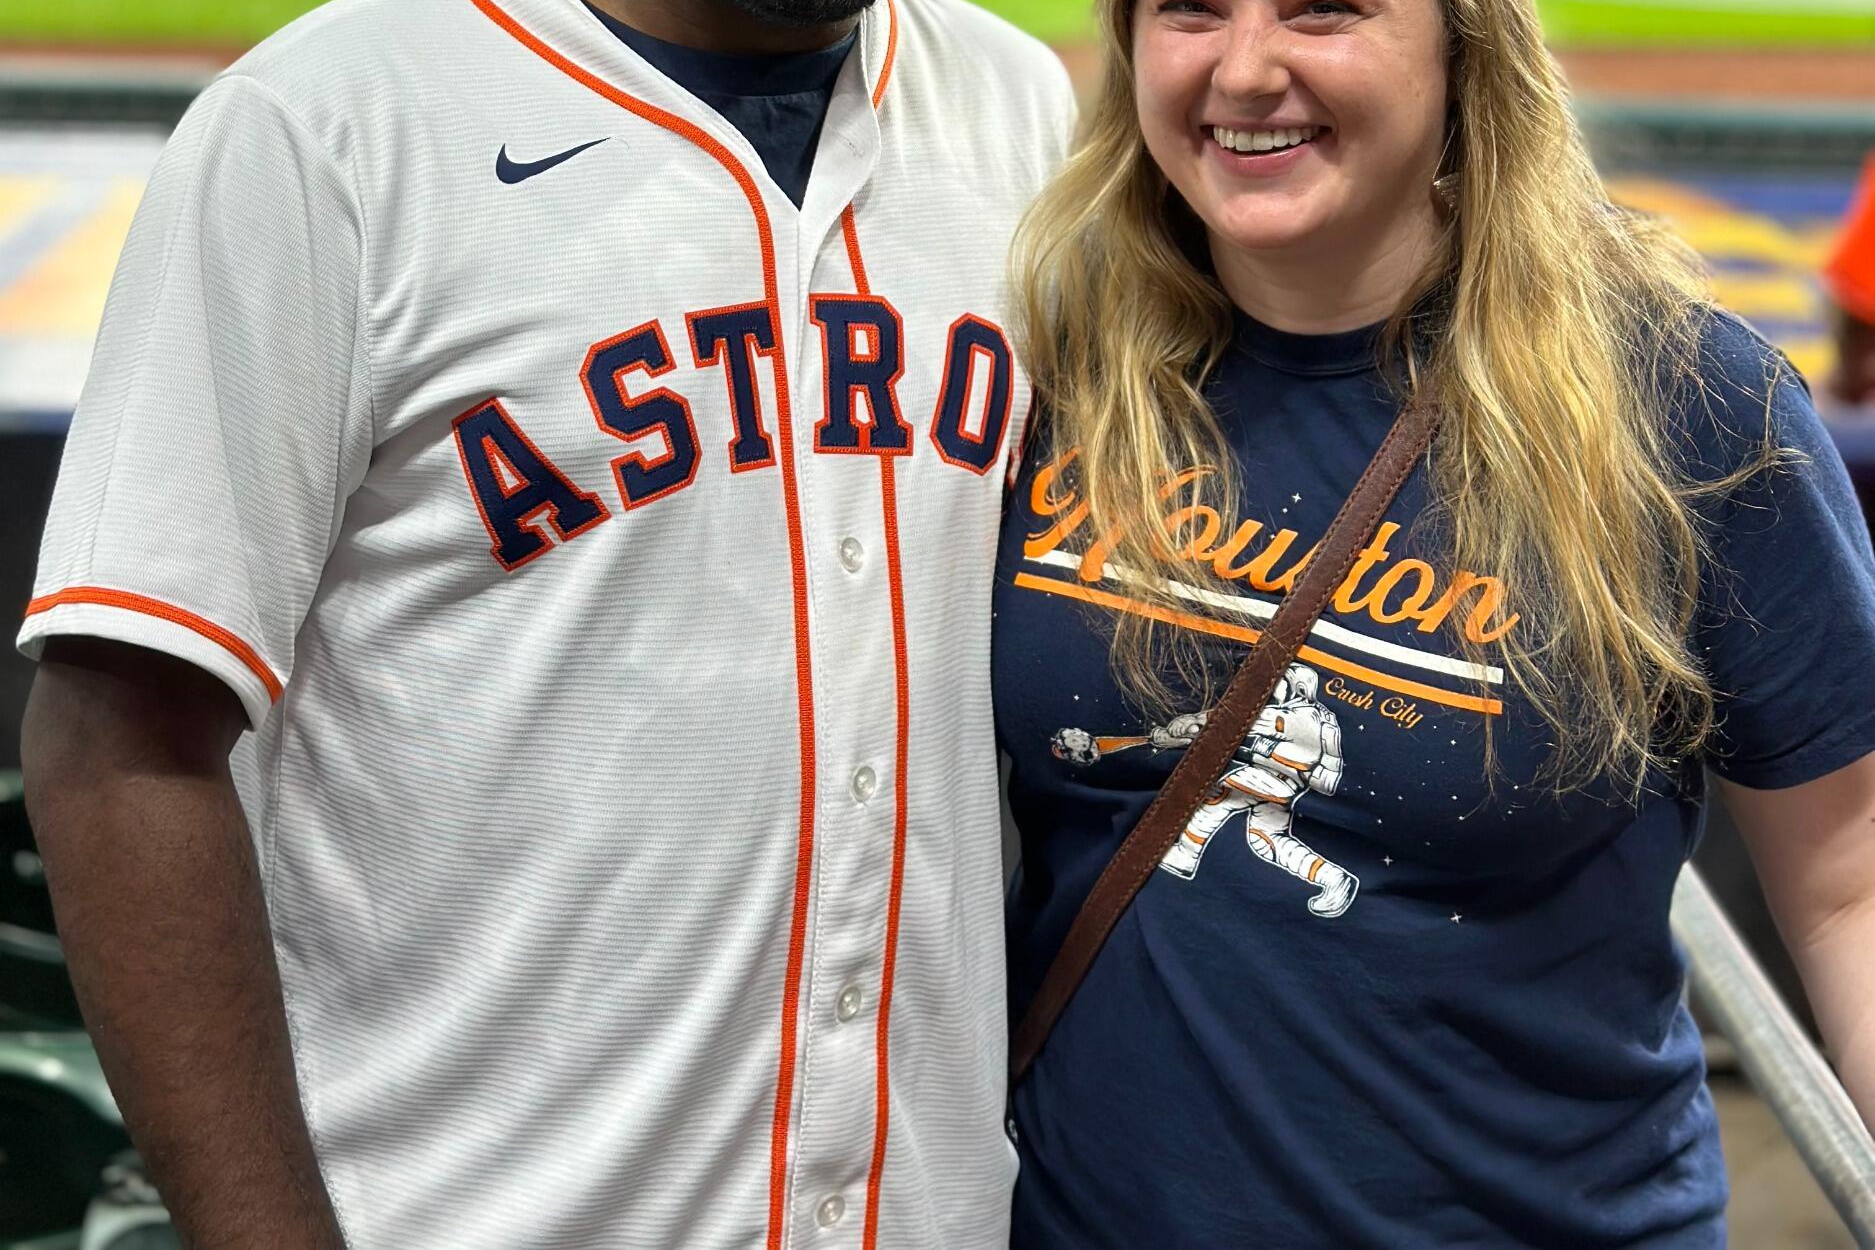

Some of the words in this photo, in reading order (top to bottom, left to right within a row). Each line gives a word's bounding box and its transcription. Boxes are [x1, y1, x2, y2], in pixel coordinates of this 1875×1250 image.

[452, 293, 1024, 572] ASTRO
[1325, 676, 1374, 711] Crush
[1379, 696, 1424, 729] City
